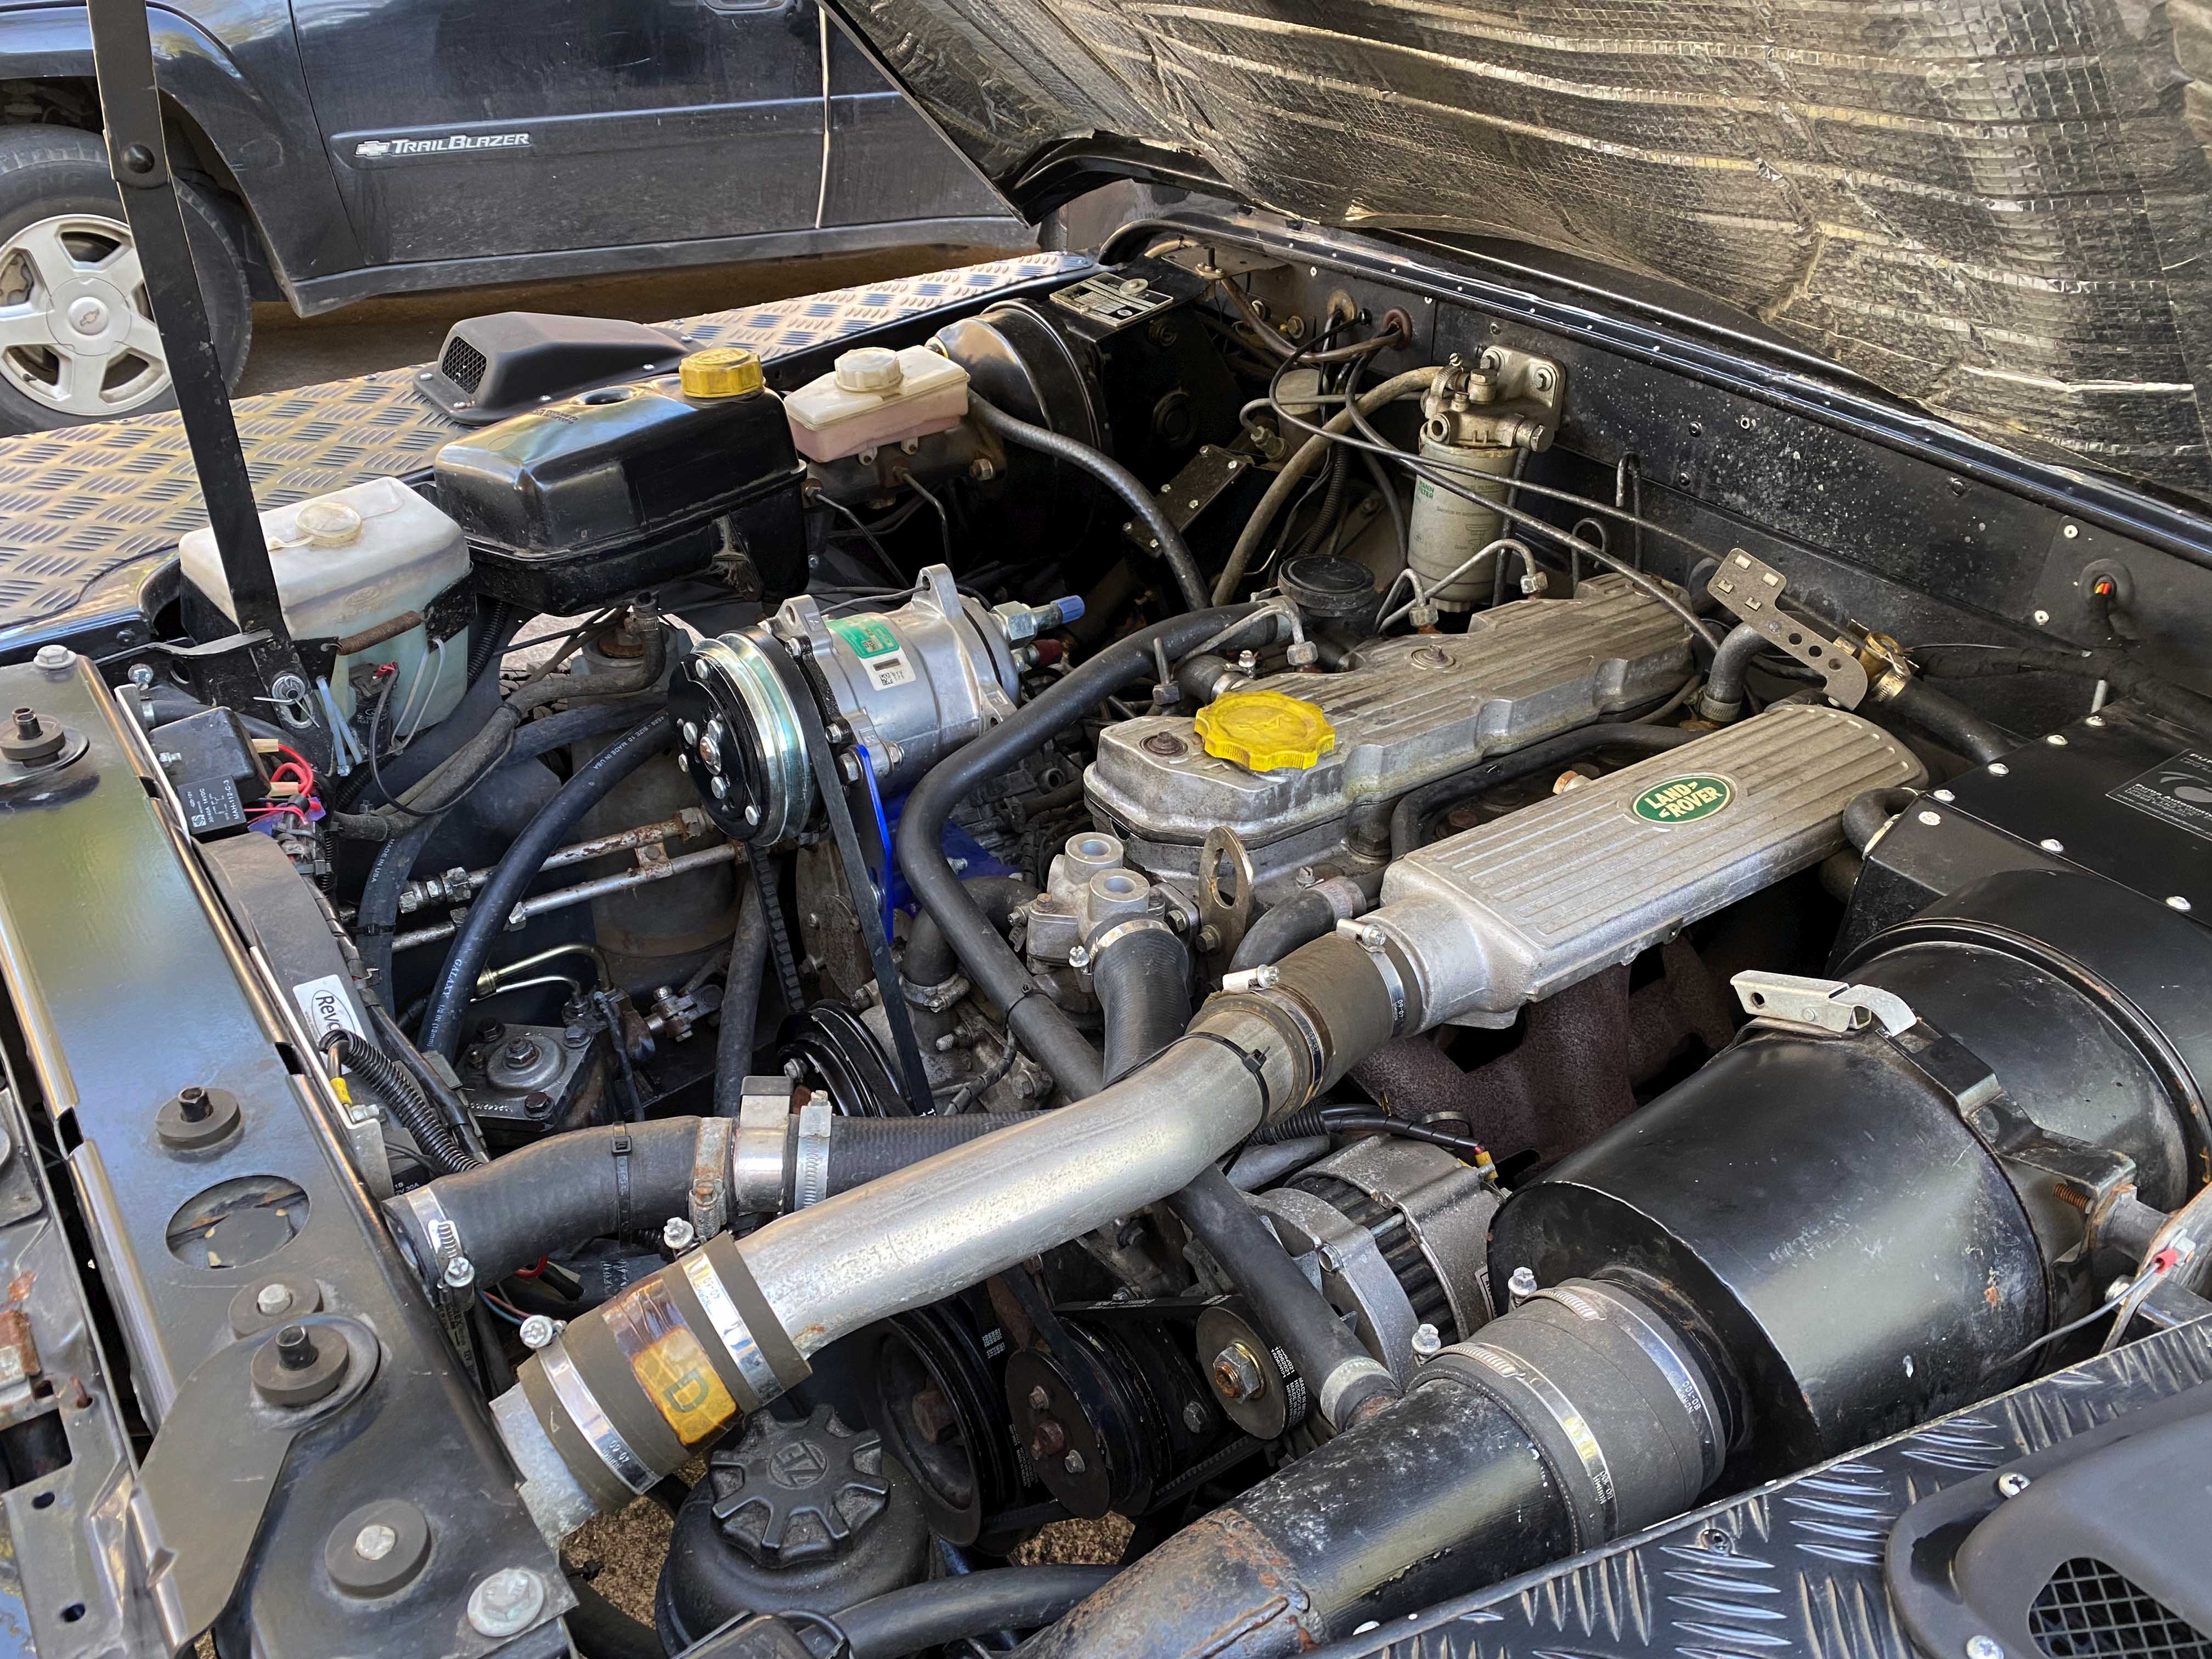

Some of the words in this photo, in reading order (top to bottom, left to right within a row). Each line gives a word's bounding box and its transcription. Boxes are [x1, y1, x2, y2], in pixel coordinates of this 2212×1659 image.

[1419, 480, 1435, 493] MANN
[611, 741, 628, 755] MADE
[593, 759, 606, 769] USA
[1644, 784, 1692, 809] LAND
[2135, 783, 2162, 795] Puma
[1665, 786, 1724, 818] ROVER
[381, 838, 395, 857] MADE
[371, 868, 381, 882] USA
[442, 958, 462, 999] GALAXY
[1308, 1031, 1319, 1051] 40-60
[1274, 1346, 1291, 1376] 16062021
[1298, 1377, 1306, 1396] MADE
[1682, 1380, 1701, 1410] 80-100
